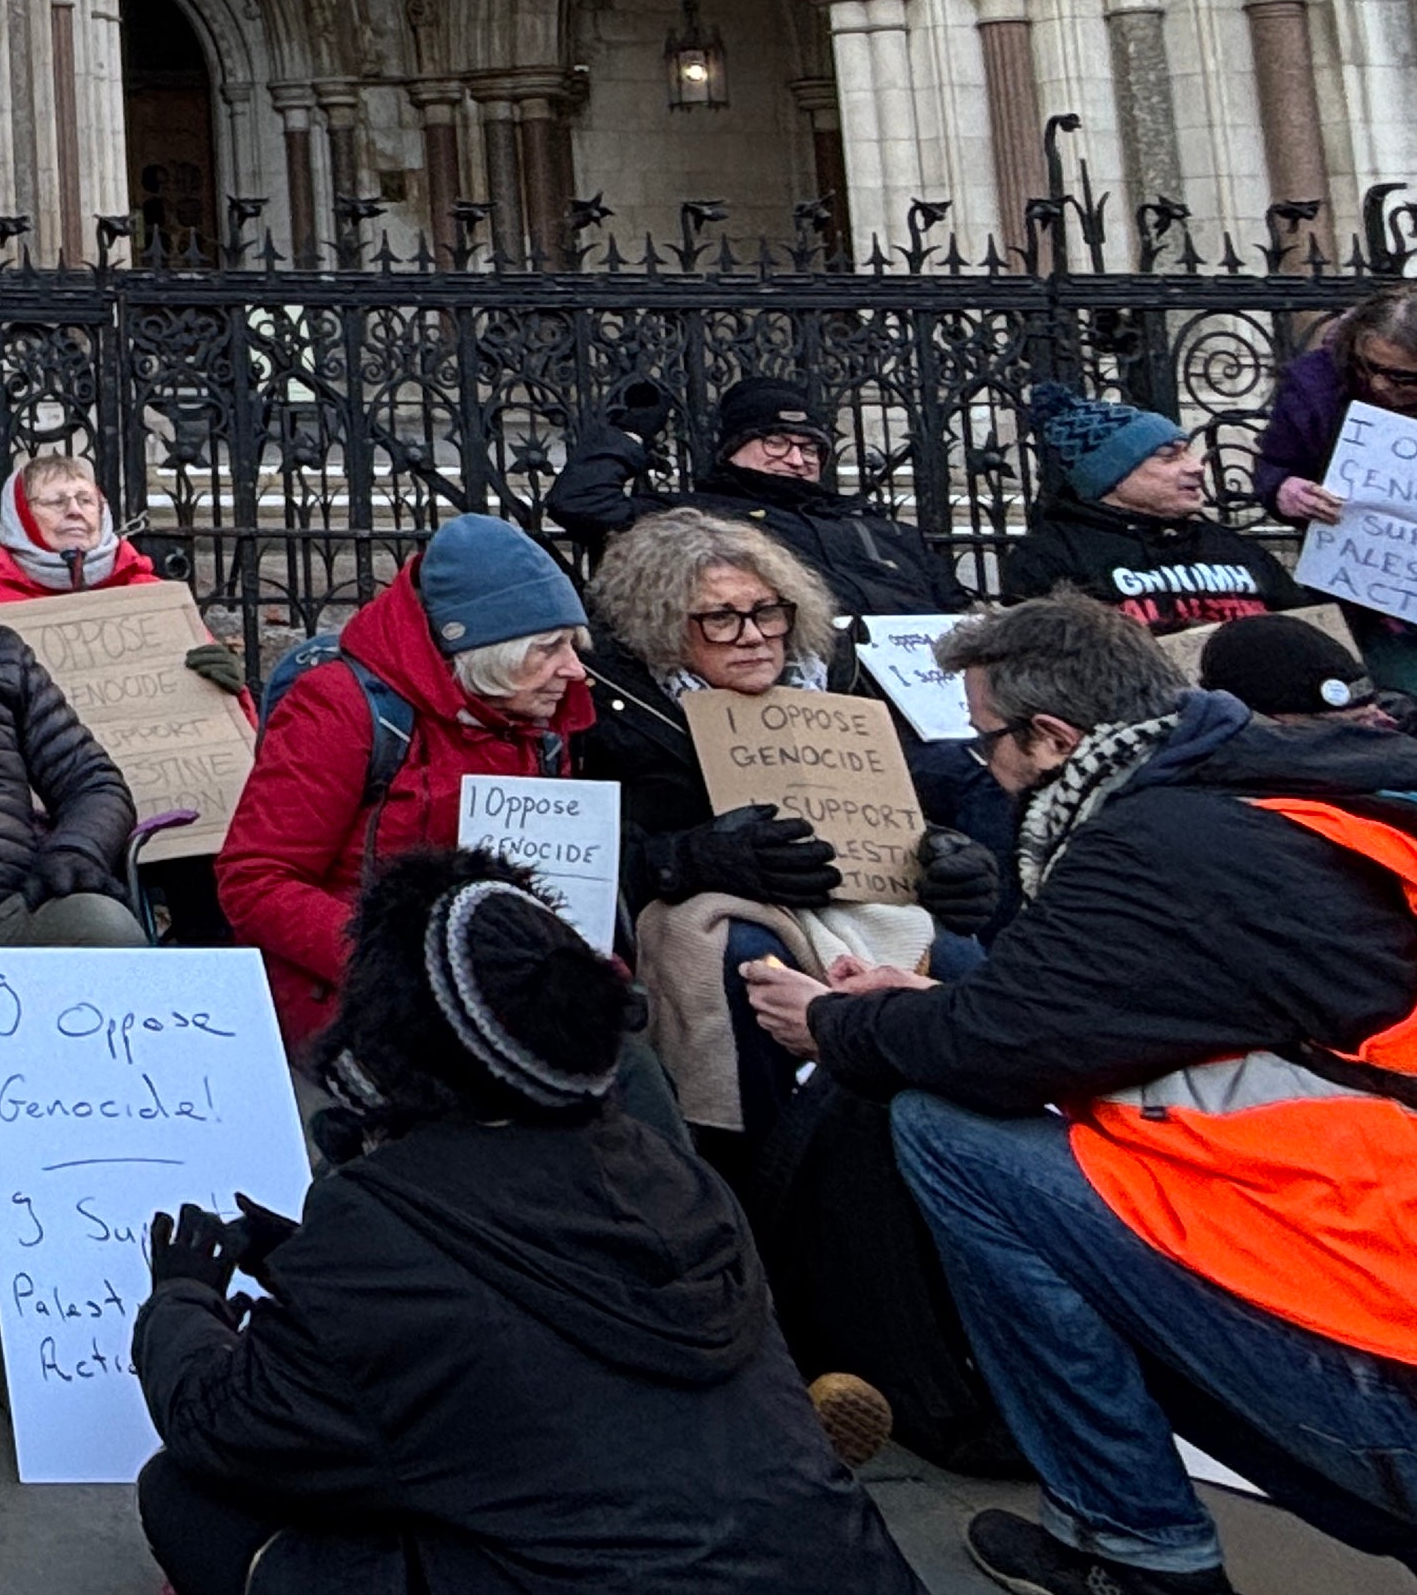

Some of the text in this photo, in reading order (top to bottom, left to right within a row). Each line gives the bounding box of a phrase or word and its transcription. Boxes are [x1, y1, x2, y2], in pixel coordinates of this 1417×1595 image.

[1342, 418, 1373, 446] I
[1316, 530, 1417, 582] PALES
[41, 616, 161, 671] OPPOSE
[71, 668, 177, 706] ENOCIDE
[727, 704, 869, 736] I OPPOSE
[730, 745, 884, 773] GENOCIDE
[470, 785, 581, 829] I Oppose
[782, 796, 917, 830] SUPPORT
[57, 1002, 237, 1065] Oppose
[12, 1272, 126, 1319] Palest
